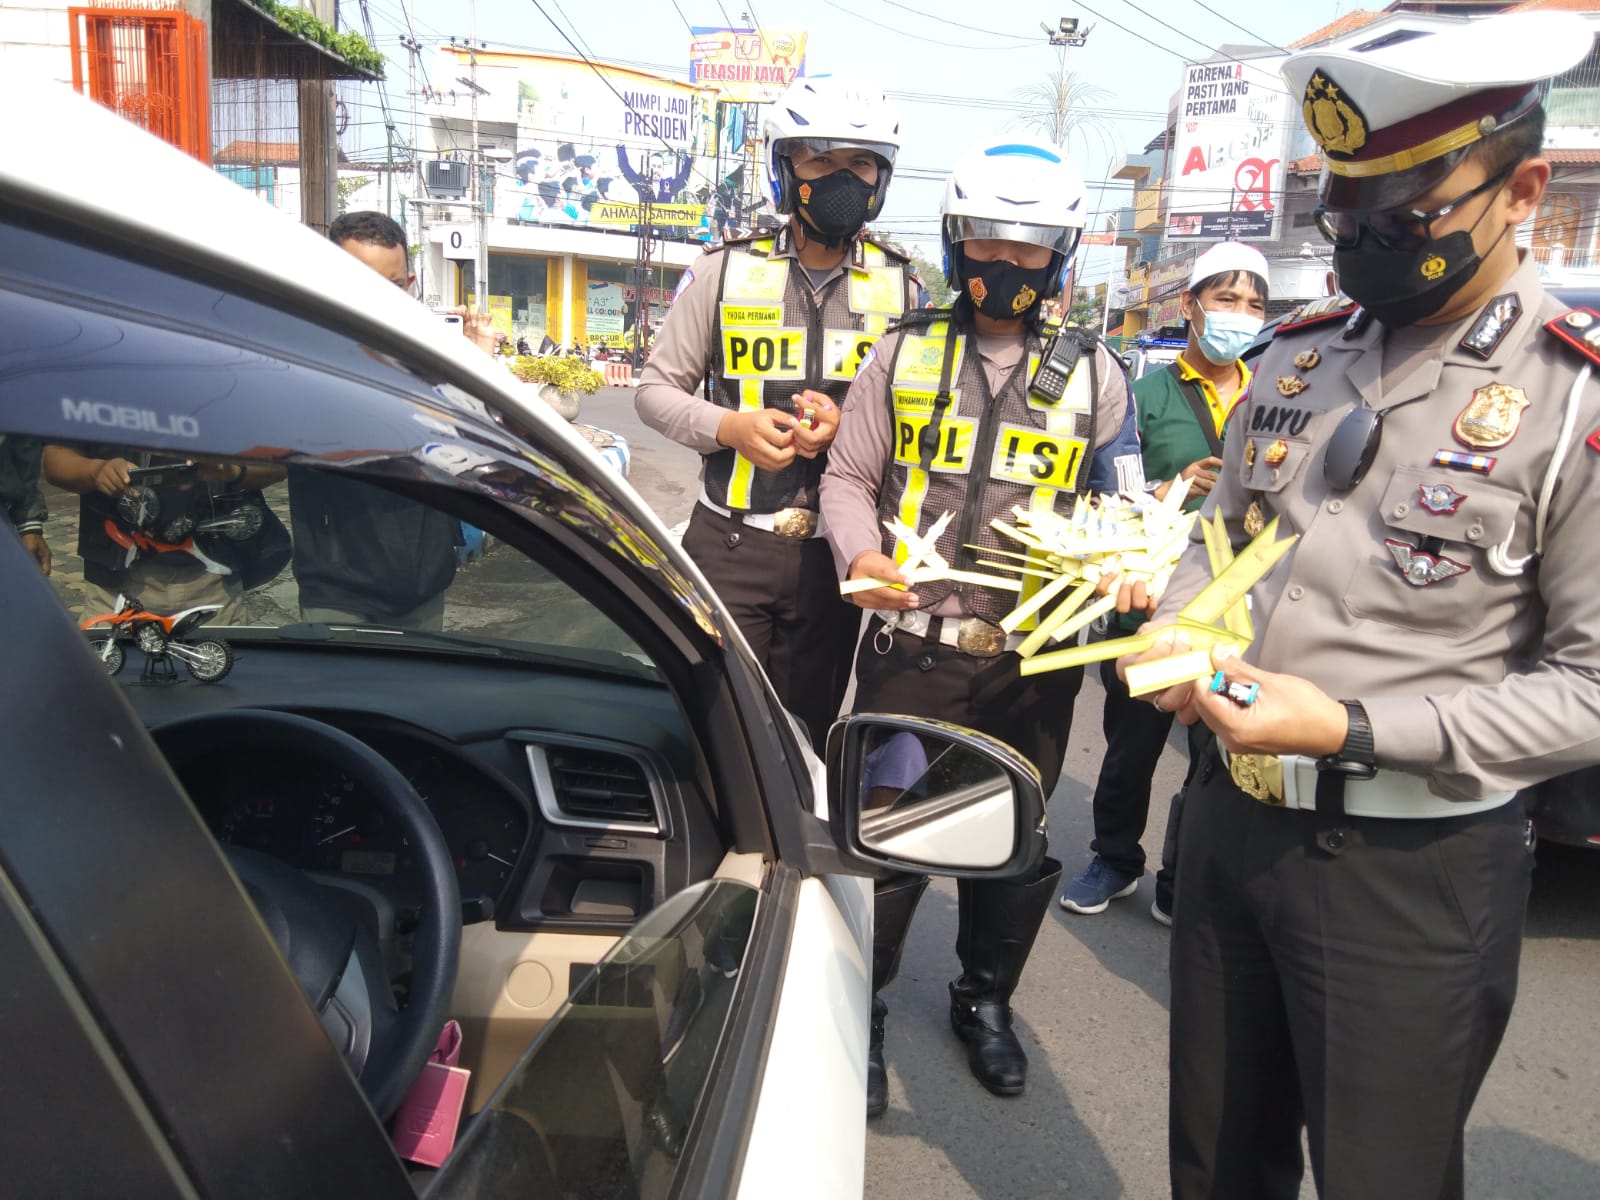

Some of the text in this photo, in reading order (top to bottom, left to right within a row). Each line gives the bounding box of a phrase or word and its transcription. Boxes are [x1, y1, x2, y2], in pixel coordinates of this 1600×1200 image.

[695, 63, 797, 83] TELASIH JAYA 2
[1189, 64, 1242, 83] KARENA A
[1187, 80, 1249, 101] PASTI YANG
[623, 90, 688, 116] MIMPI JADI
[1185, 98, 1237, 117] PERTAMA
[624, 111, 687, 142] PRESIDEN
[600, 206, 697, 221] AHMAD SAHRONI
[747, 311, 776, 321] PERMANA
[730, 336, 874, 372] POL IS
[61, 398, 200, 438] MOBILIO
[1252, 405, 1312, 436] BAYU
